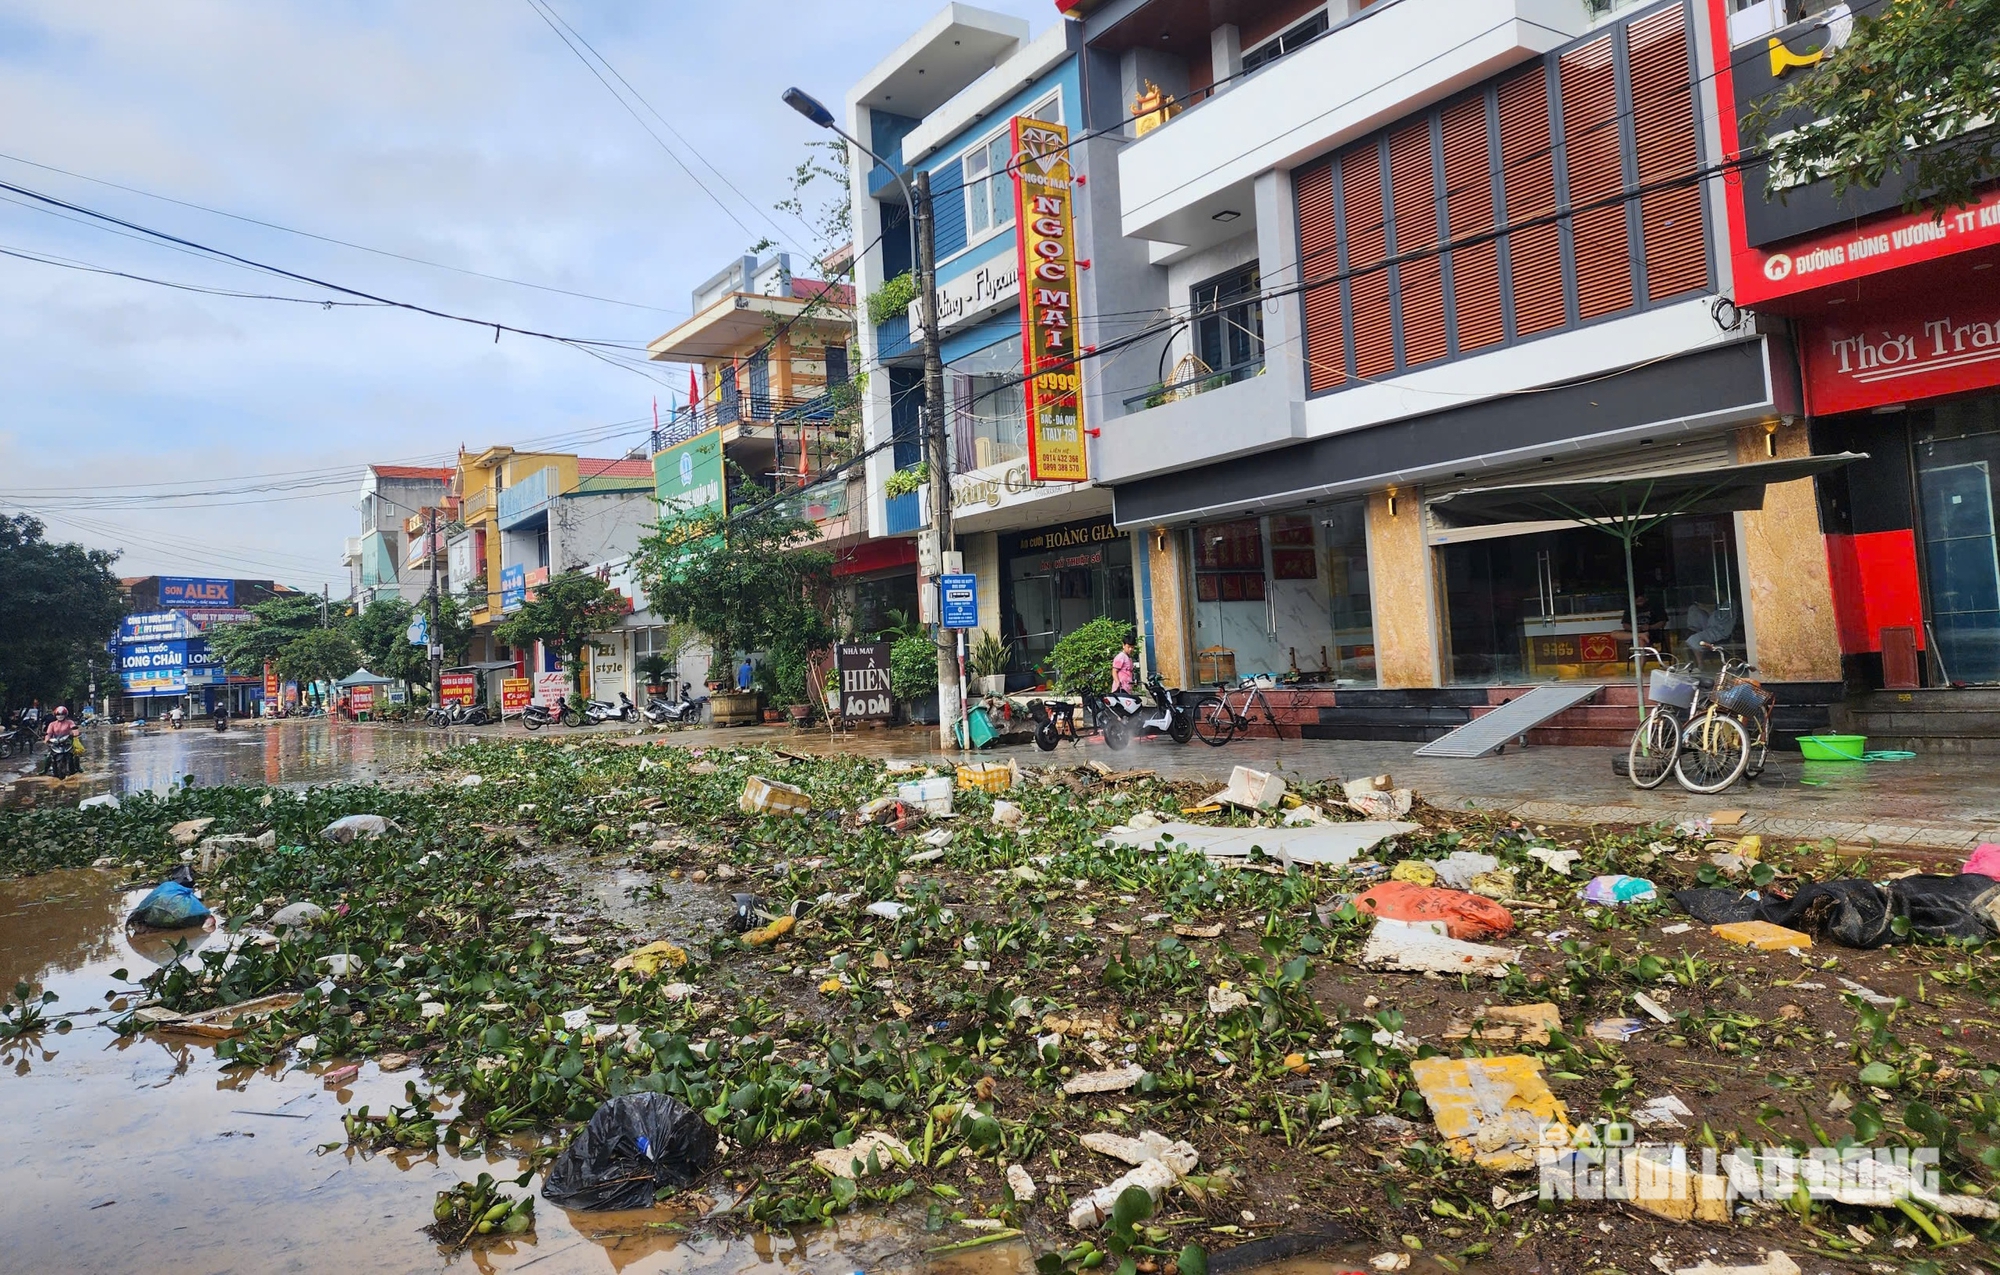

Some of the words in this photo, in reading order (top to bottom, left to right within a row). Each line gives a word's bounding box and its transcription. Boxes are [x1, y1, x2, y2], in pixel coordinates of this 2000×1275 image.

[1032, 196, 1065, 282] NGỌC
[1796, 246, 1845, 275] ĐƯỜNG
[1847, 235, 1890, 262] HÙNG
[1892, 219, 1947, 250] VƯƠNG
[1955, 211, 1976, 233] TT
[974, 268, 1019, 301] Flycam
[1035, 288, 1070, 348] MAI
[1832, 331, 1918, 374] Thời
[1038, 372, 1078, 391] 9999
[1040, 413, 1053, 427] BẠC
[1042, 454, 1056, 462] 0914
[951, 475, 1001, 508] oàng
[1045, 526, 1089, 549] HOÀNG
[1091, 523, 1116, 541] GIA
[1066, 553, 1089, 567] THUẬT
[164, 586, 184, 595] SƠN
[184, 583, 230, 600] ALEX
[192, 613, 209, 621] CÔNG
[135, 645, 148, 654] NHÀ
[148, 642, 168, 653] THUỐC
[597, 643, 617, 657] Hi
[843, 646, 859, 655] NHÀ
[860, 647, 875, 655] MAY
[122, 655, 151, 668] LONG
[152, 650, 182, 666] CHÂU
[595, 662, 623, 675] style
[843, 657, 891, 693] HIỀN
[845, 695, 867, 716] ÁO
[867, 693, 890, 715] DÀI
